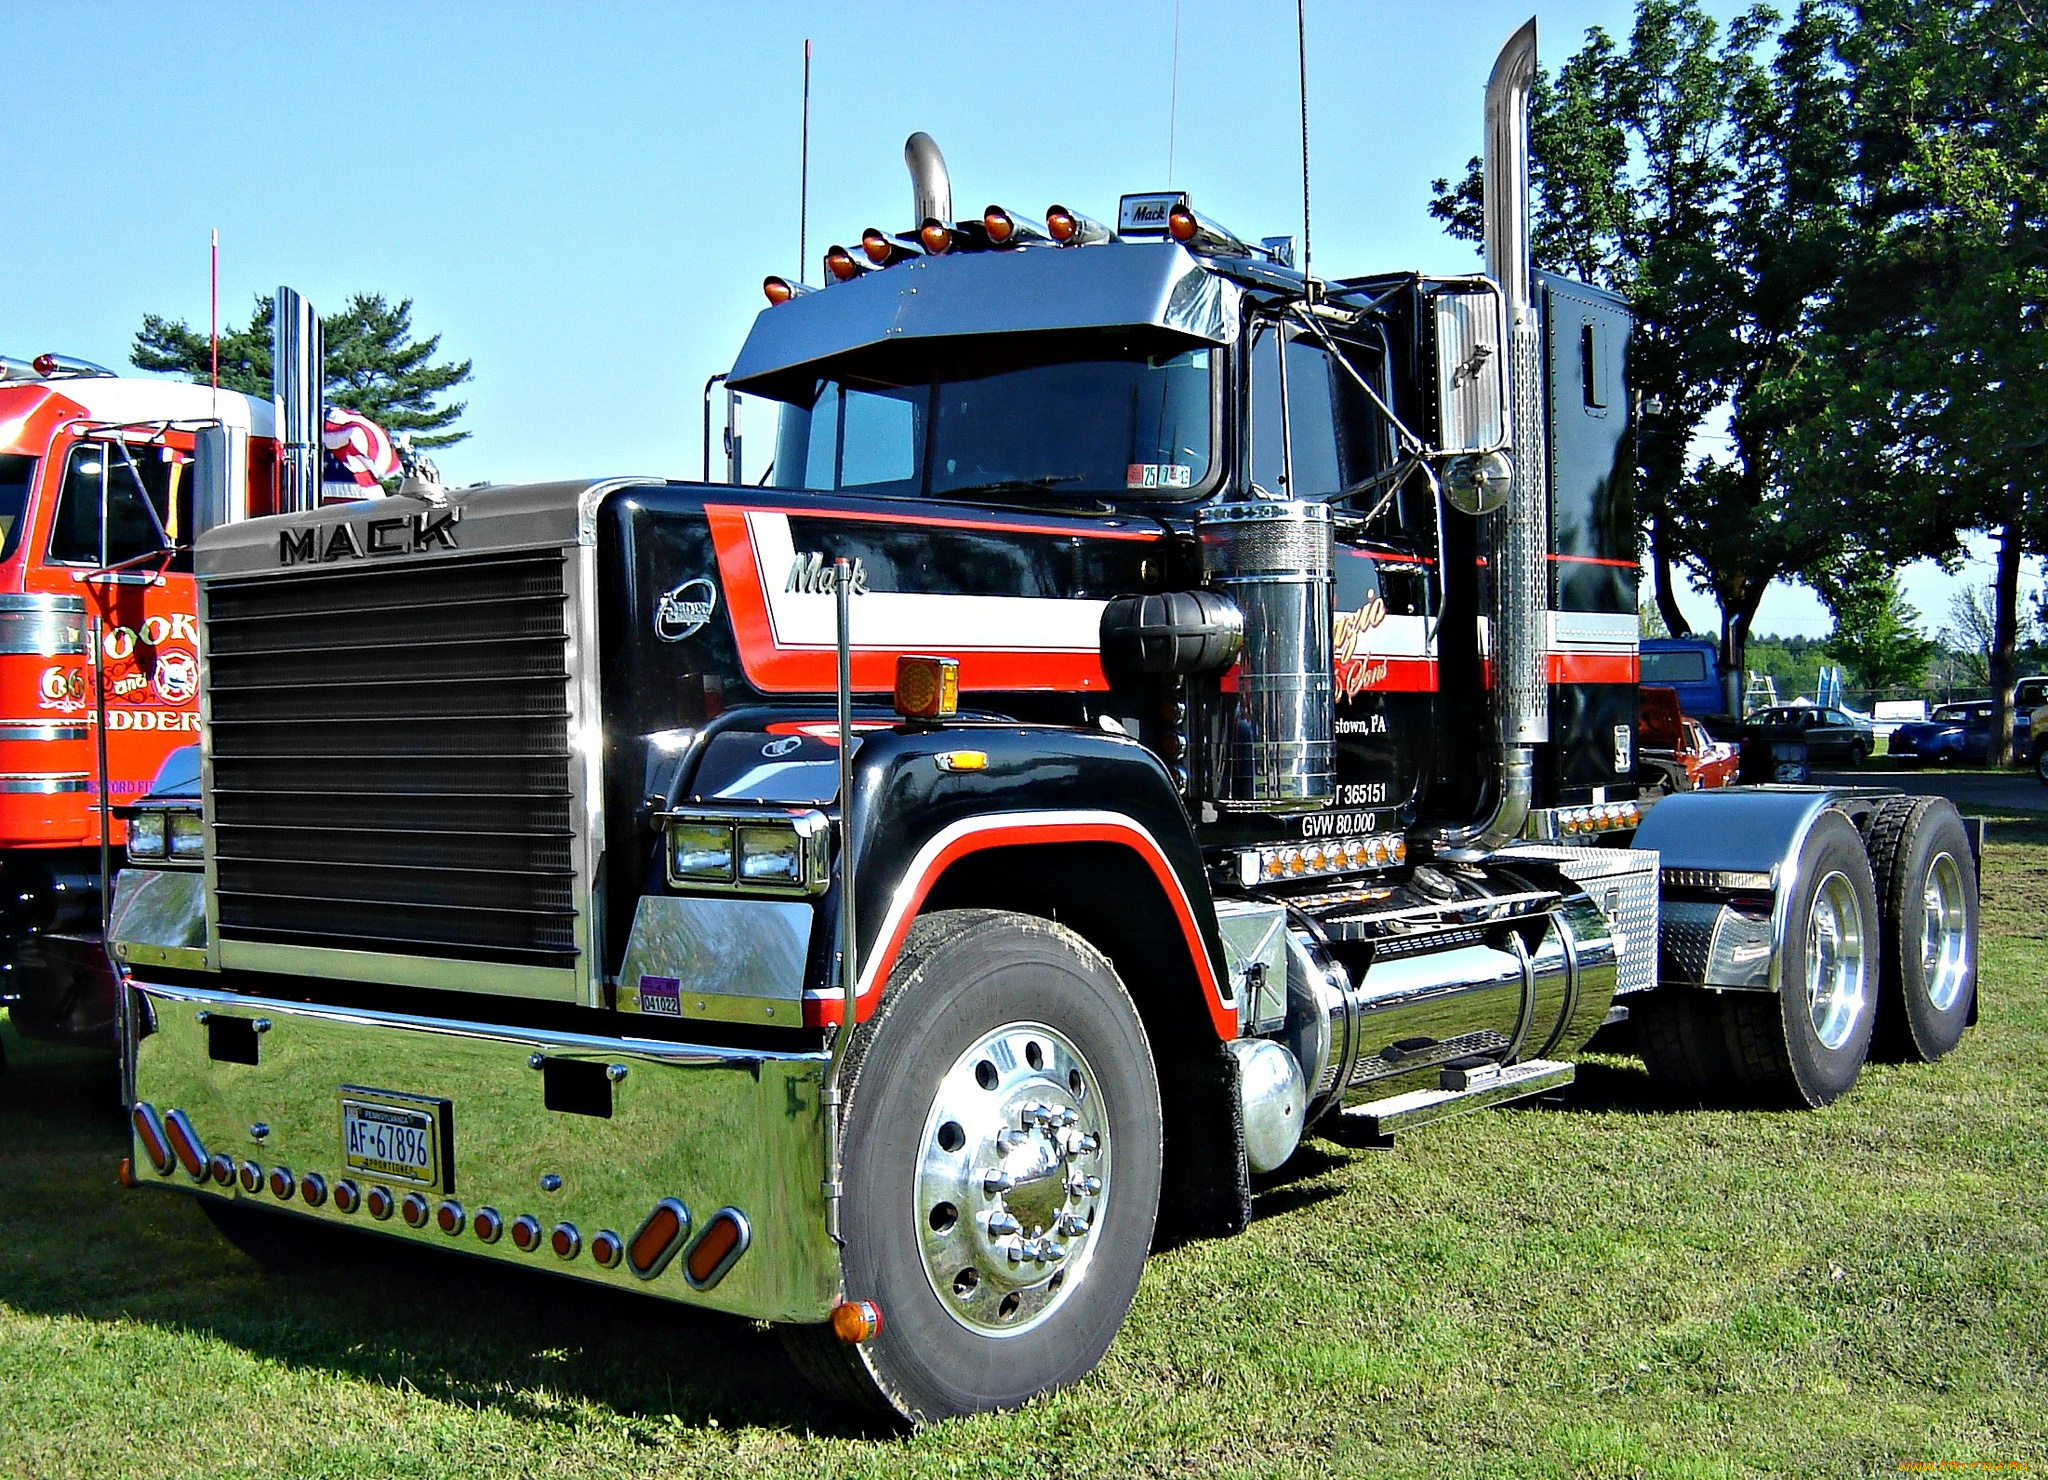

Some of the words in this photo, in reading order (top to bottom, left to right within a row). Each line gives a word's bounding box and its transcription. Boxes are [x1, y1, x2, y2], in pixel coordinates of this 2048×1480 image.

[1133, 205, 1165, 222] Mack
[1144, 466, 1156, 487] 25
[280, 506, 461, 566] MACK
[785, 551, 870, 595] Mak
[41, 666, 84, 698] 66
[113, 672, 148, 695] and
[1371, 714, 1387, 733] PA
[1344, 782, 1386, 805] 365151
[1302, 815, 1335, 838] GVW
[1336, 812, 1376, 836] 80,000
[645, 996, 677, 1012] 041022
